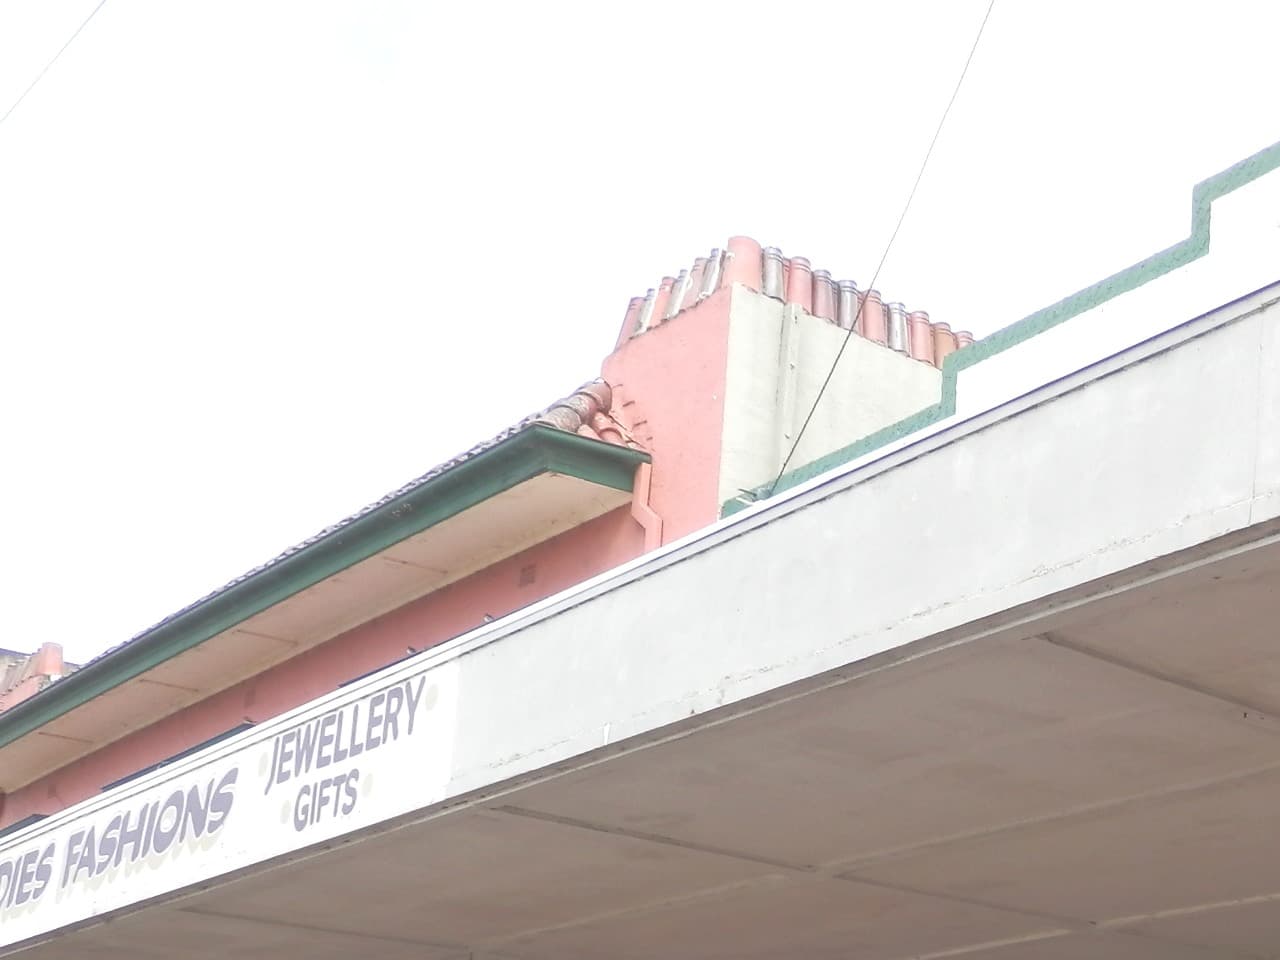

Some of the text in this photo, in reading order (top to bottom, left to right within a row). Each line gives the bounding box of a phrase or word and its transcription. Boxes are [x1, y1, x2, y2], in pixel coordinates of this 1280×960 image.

[265, 676, 426, 796] JEWELLERY
[62, 767, 239, 888] FASHIONS
[293, 768, 359, 832] GIFTS
